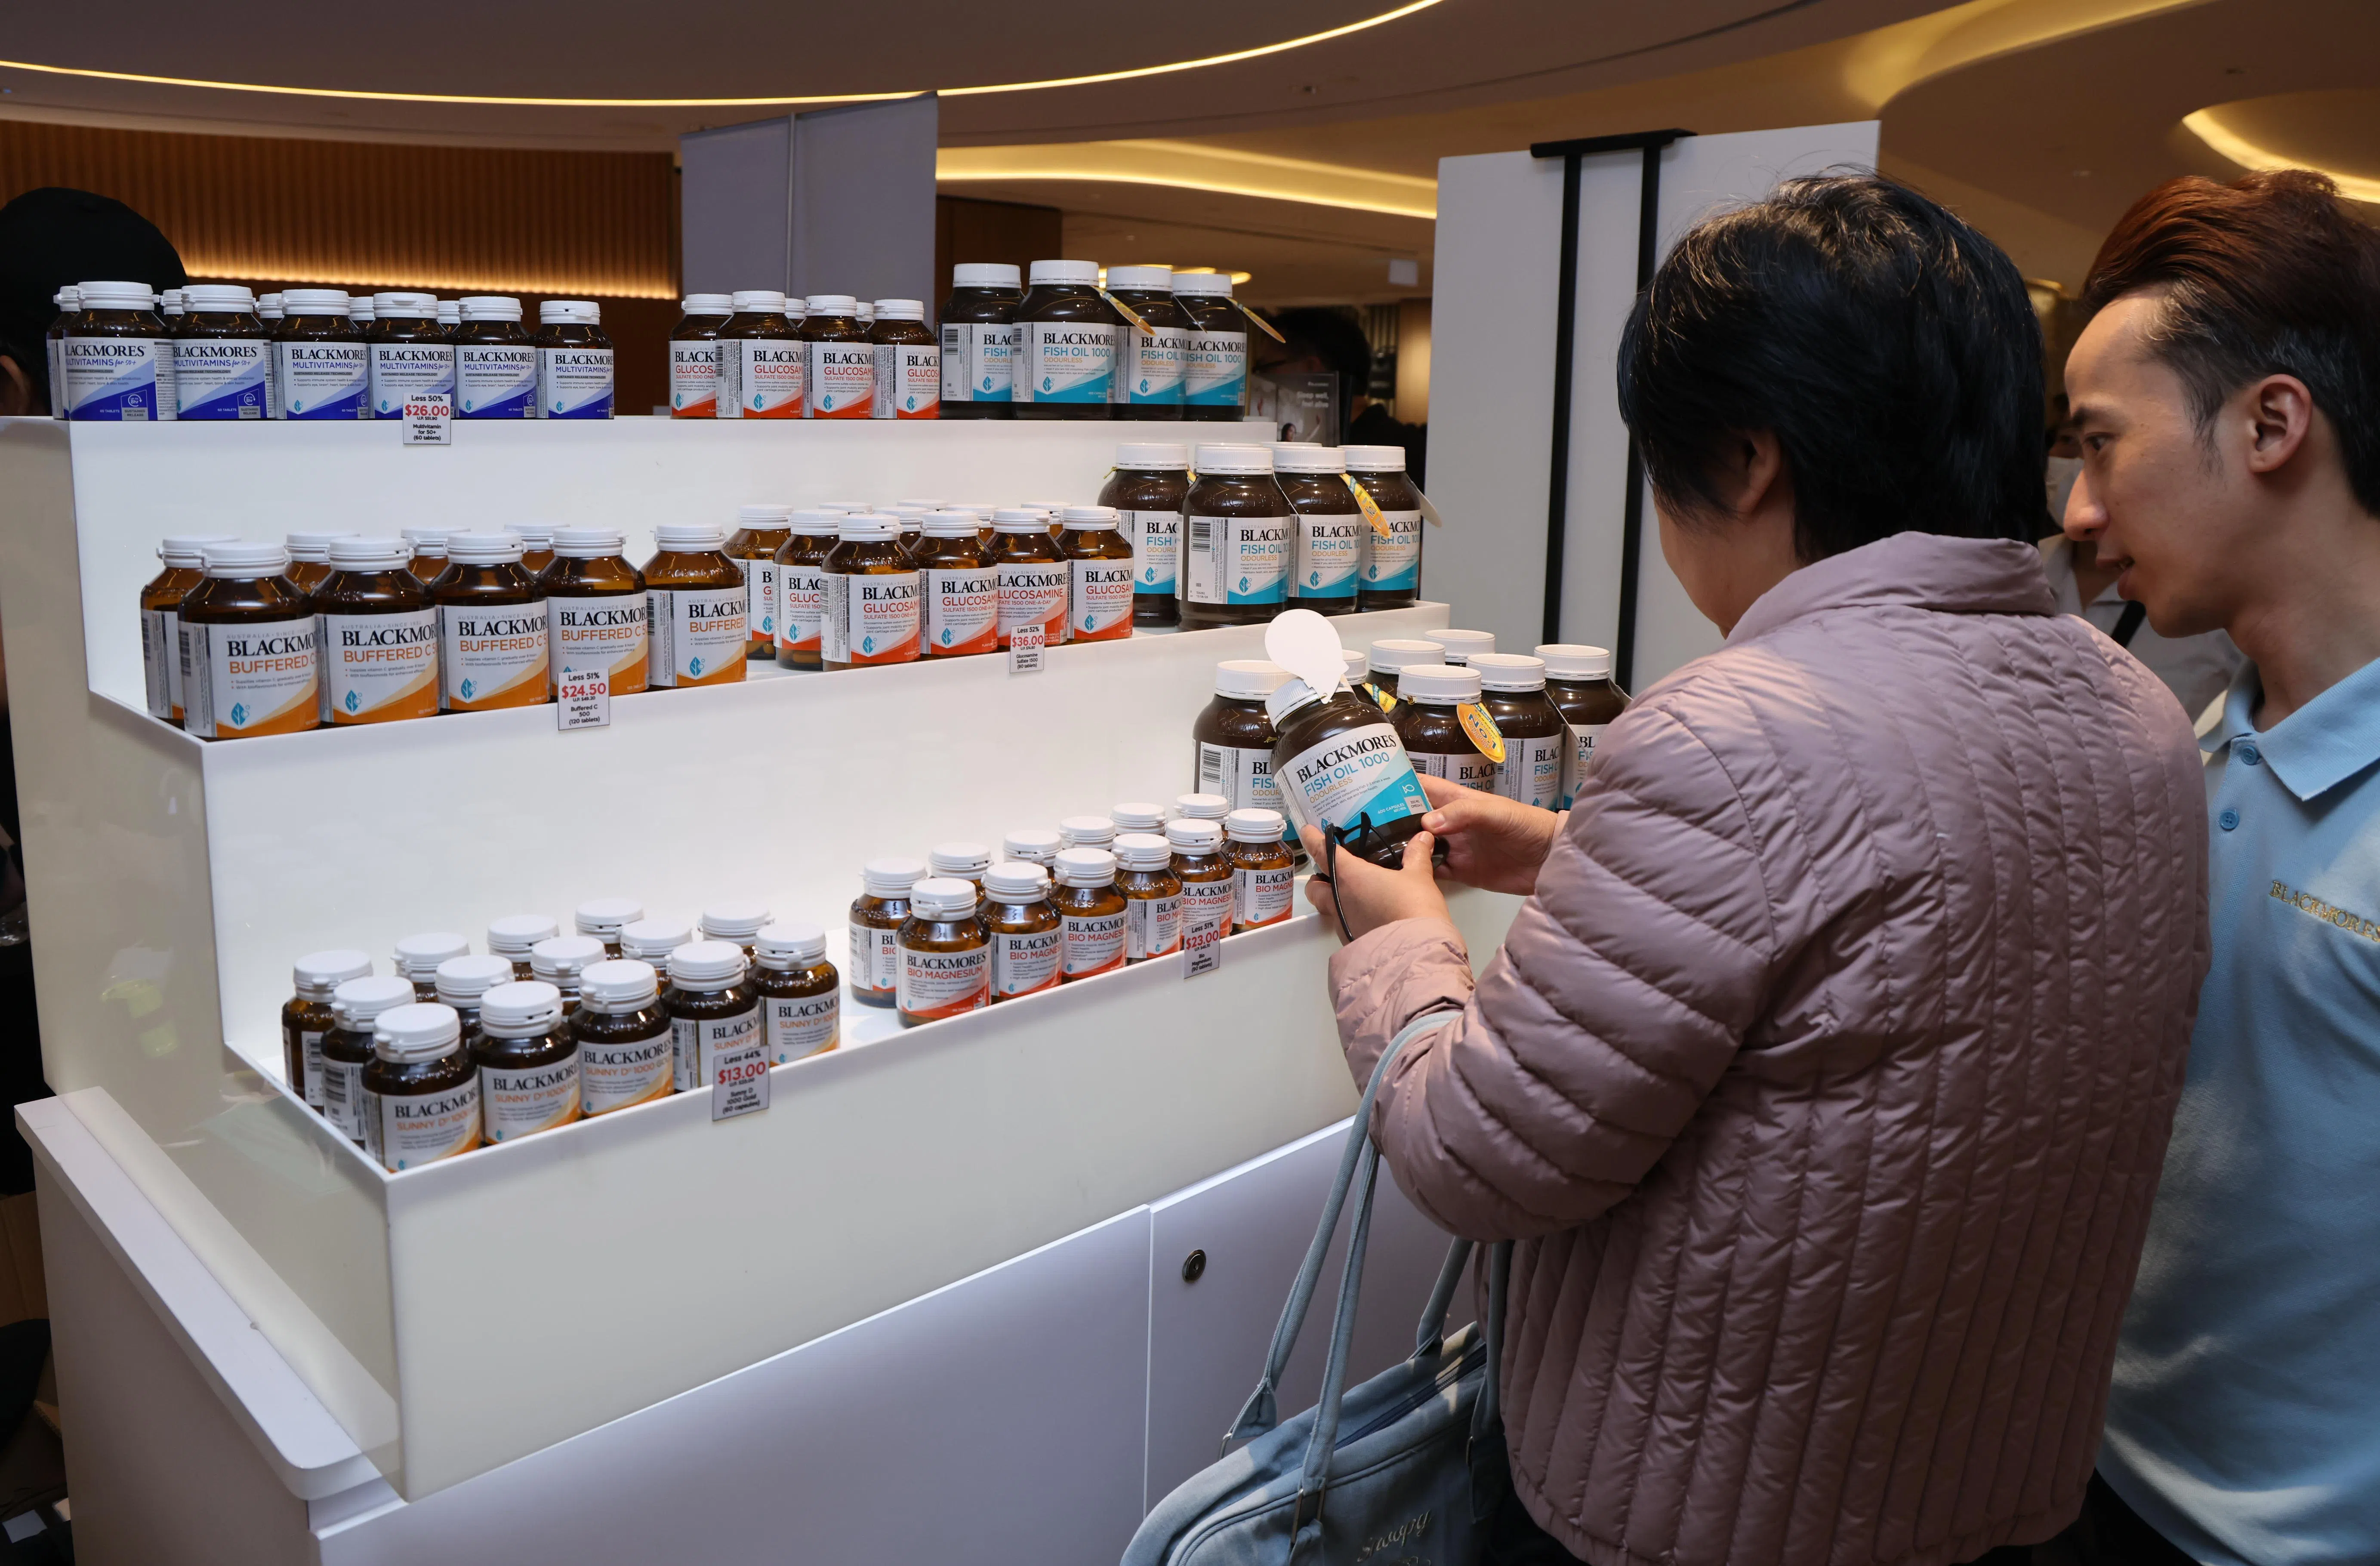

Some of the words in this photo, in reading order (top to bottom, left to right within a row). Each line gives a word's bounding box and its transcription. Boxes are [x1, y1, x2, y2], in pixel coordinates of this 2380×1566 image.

[65, 345, 145, 357] LACKMORES
[173, 346, 257, 357] BLACKMORES
[291, 349, 366, 360] BLACKMORES
[379, 351, 452, 361] BLACKMORES
[984, 348, 1007, 357] FISH
[1044, 347, 1068, 357] FISH
[1072, 348, 1089, 357] OIL
[1093, 348, 1110, 358] 1000
[1141, 350, 1164, 359] FISH
[1166, 351, 1179, 360] OIL
[114, 358, 123, 367] for
[463, 352, 534, 362] BLACKMORES
[1206, 354, 1222, 363] OIL
[1224, 354, 1242, 363] 1000
[232, 359, 240, 368] for
[755, 365, 802, 374] GLUCOSAM
[405, 404, 449, 416] $26.00
[1147, 537, 1172, 546] FISH
[1312, 540, 1335, 550] FISH
[1339, 539, 1352, 549] OIL
[1397, 536, 1410, 544] OIL
[1241, 545, 1265, 554] FISH
[1269, 545, 1281, 554] OIL
[998, 588, 1063, 599] LUCOSAMINE
[458, 616, 548, 636] BLACKMOR
[690, 617, 744, 632] BUFFERED
[342, 624, 436, 646] BLACKMOR
[562, 628, 632, 641] BUFFERED
[635, 626, 641, 636] C
[460, 637, 534, 652] BUFFERED
[537, 635, 542, 646] C
[1012, 635, 1043, 648] $36.00
[344, 646, 422, 663] BUFFERED
[425, 645, 431, 656] C
[229, 656, 308, 674] BUFFERED
[310, 655, 315, 665] C
[561, 682, 606, 699] $24.50
[1468, 713, 1496, 749] NO.1
[1296, 735, 1396, 784] BLACKMORES
[1304, 773, 1332, 797] FISH
[1334, 764, 1358, 779] OIL
[1359, 752, 1389, 769] 1000
[1535, 765, 1553, 775] FISH
[1310, 777, 1353, 803] ODOURLESS
[1342, 788, 1359, 798] consuming
[1386, 803, 1405, 811] CAPSULES
[1157, 914, 1174, 922] BIO
[1186, 930, 1219, 950] $23.00
[907, 953, 986, 969] BLACKMORES
[1010, 952, 1027, 960] BIO
[1192, 957, 1212, 966] Magnesium
[1199, 962, 1212, 970] tablets)
[908, 968, 922, 977] BIO
[925, 966, 983, 980] MAGNESIUM
[779, 1017, 811, 1029] SUNNY
[714, 1038, 744, 1051] SUNNY
[724, 1056, 741, 1064] Less
[744, 1050, 761, 1059] 44%
[586, 1067, 618, 1076] SUNNY
[718, 1061, 766, 1085] $13.00
[495, 1094, 530, 1103] SUNNY
[397, 1119, 435, 1131] SUNNY
